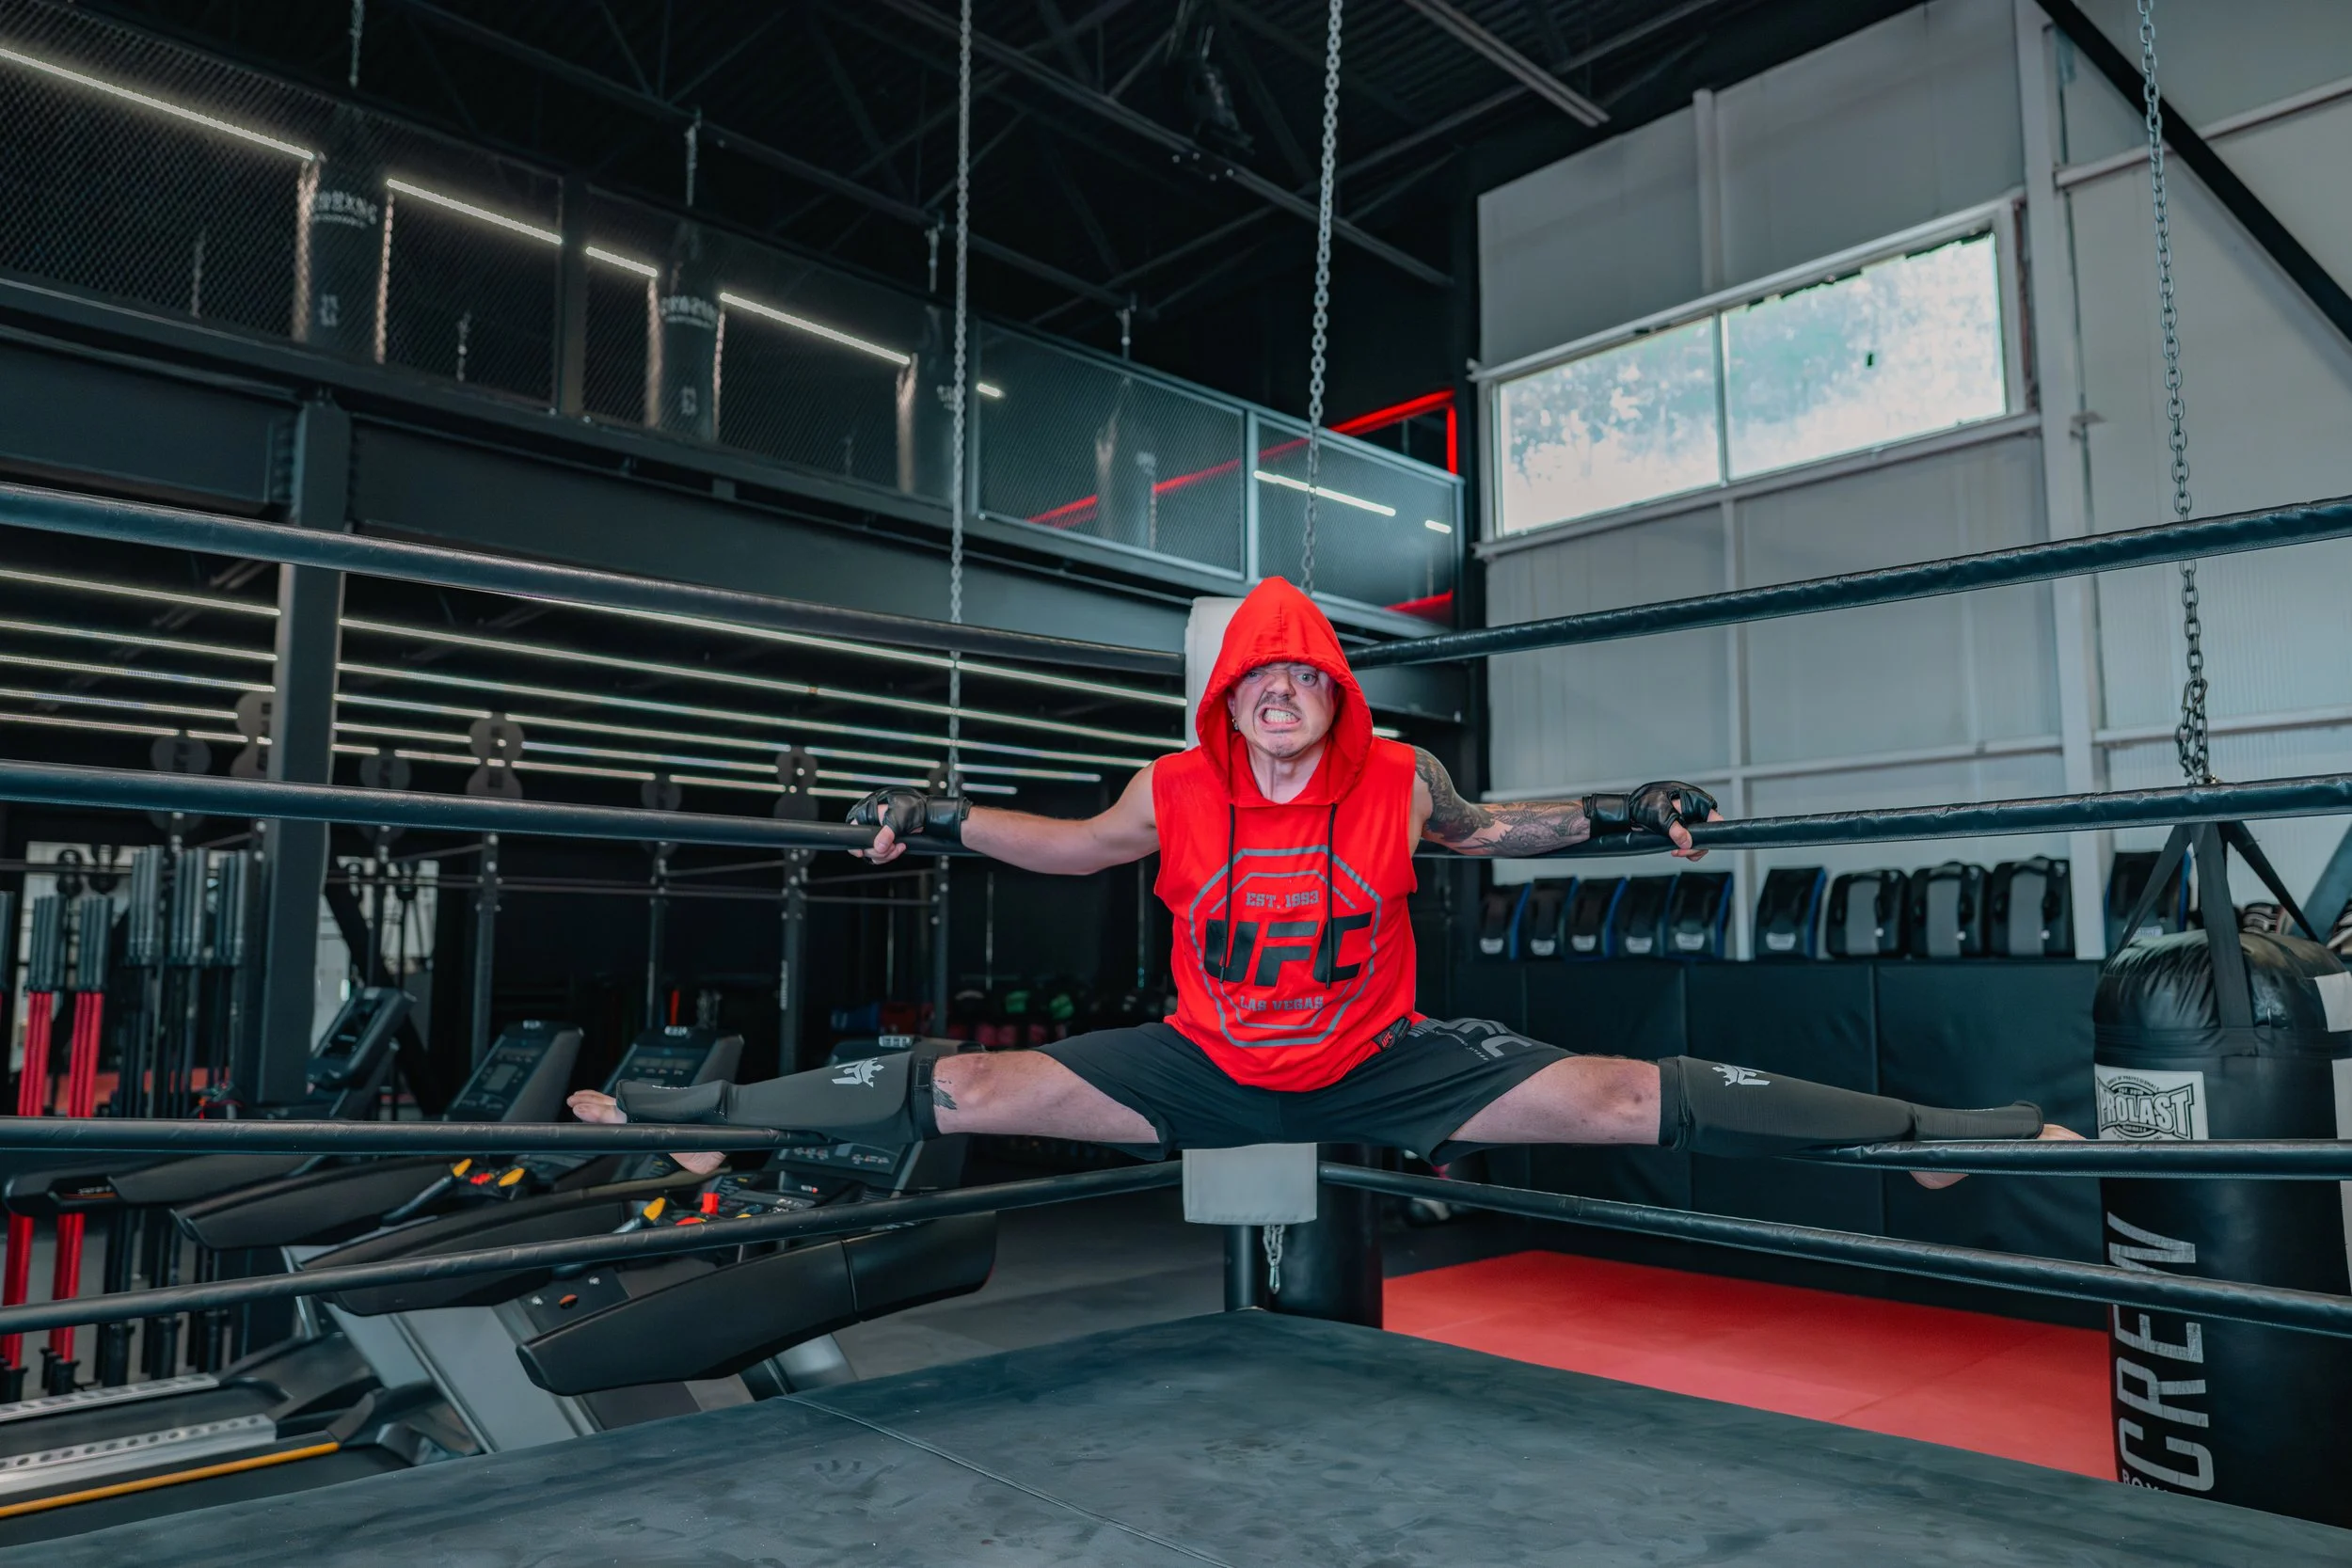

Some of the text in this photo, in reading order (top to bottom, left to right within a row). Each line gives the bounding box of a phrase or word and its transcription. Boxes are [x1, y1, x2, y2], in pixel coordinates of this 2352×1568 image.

[1246, 890, 1320, 910] EST. 1993
[1204, 911, 1373, 987] UFC
[1240, 995, 1324, 1011] LAS VEGAS
[1381, 1030, 1394, 1048] UFC
[2098, 1085, 2193, 1138] PROLAST
[2106, 1212, 2215, 1493] CREW
